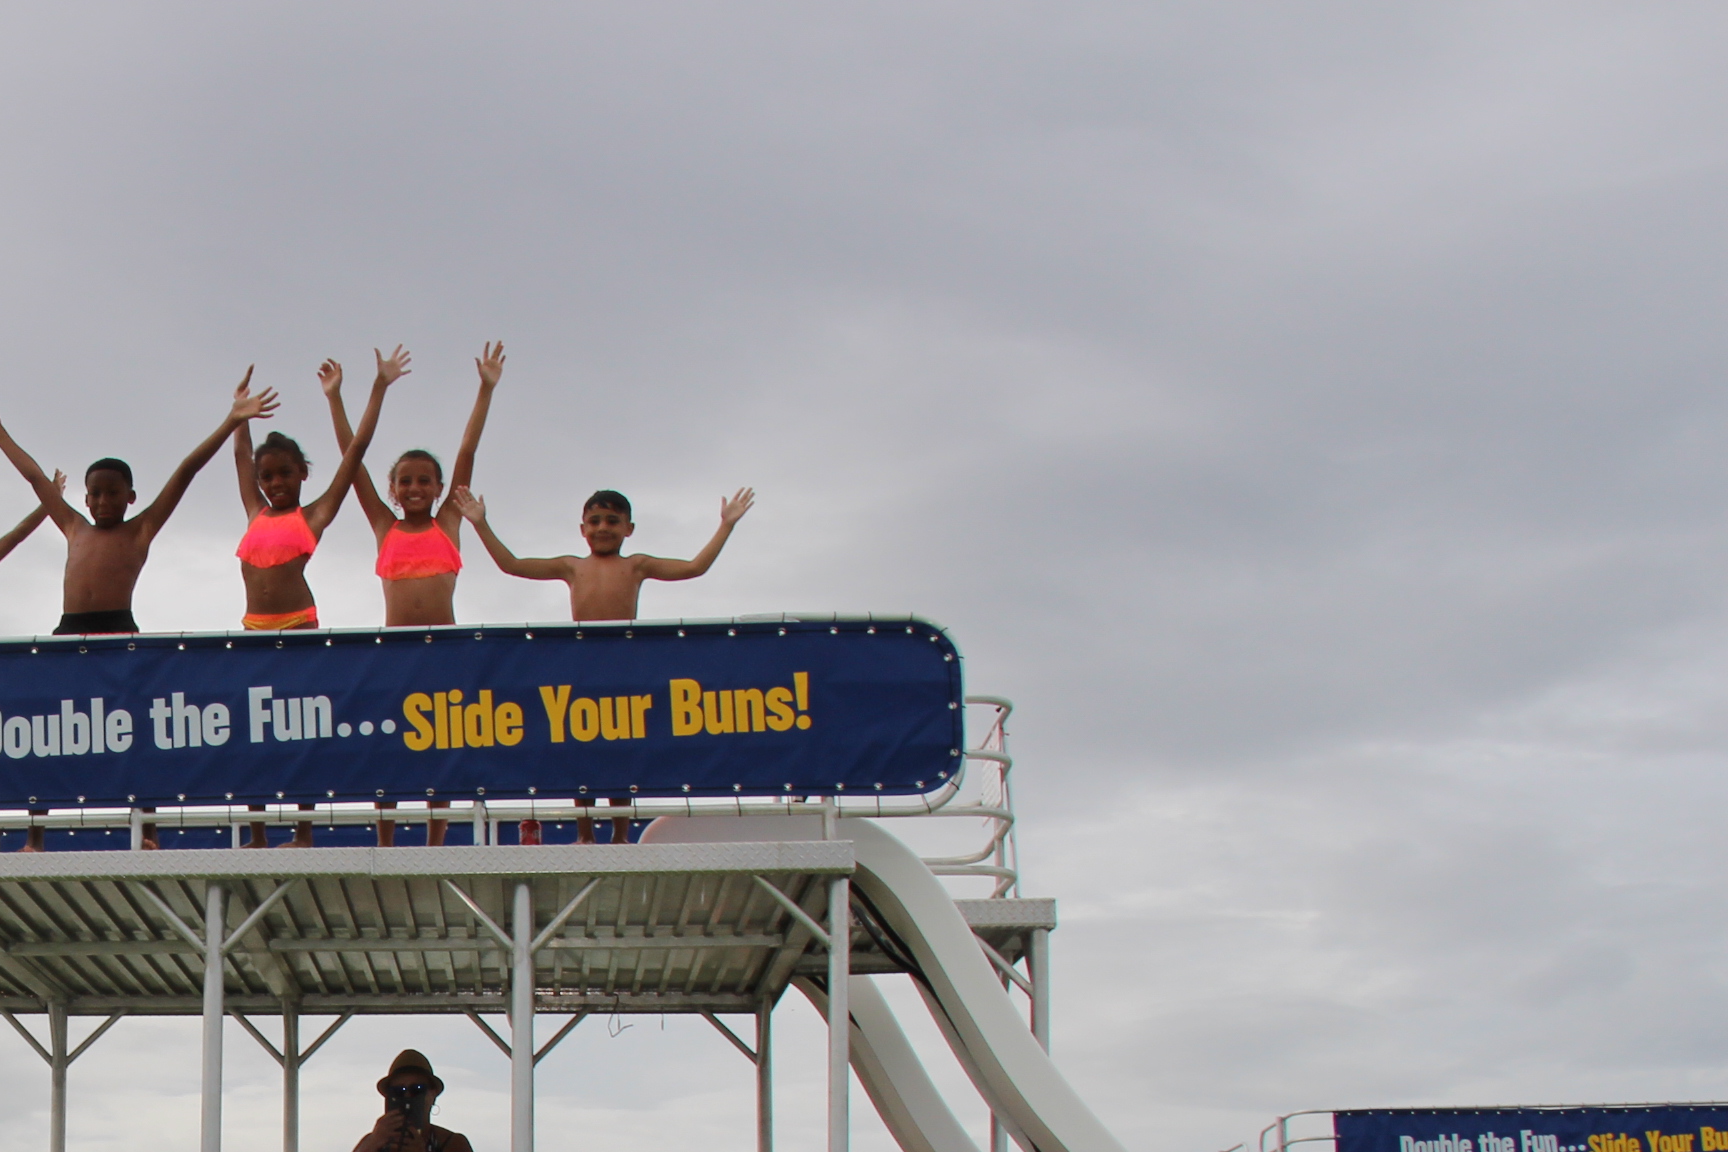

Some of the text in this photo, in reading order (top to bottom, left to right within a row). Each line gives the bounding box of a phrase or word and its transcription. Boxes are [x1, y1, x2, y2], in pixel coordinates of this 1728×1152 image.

[150, 692, 230, 749] the
[403, 690, 524, 751] Slide
[540, 686, 651, 742] Your
[670, 673, 810, 738] Buns!
